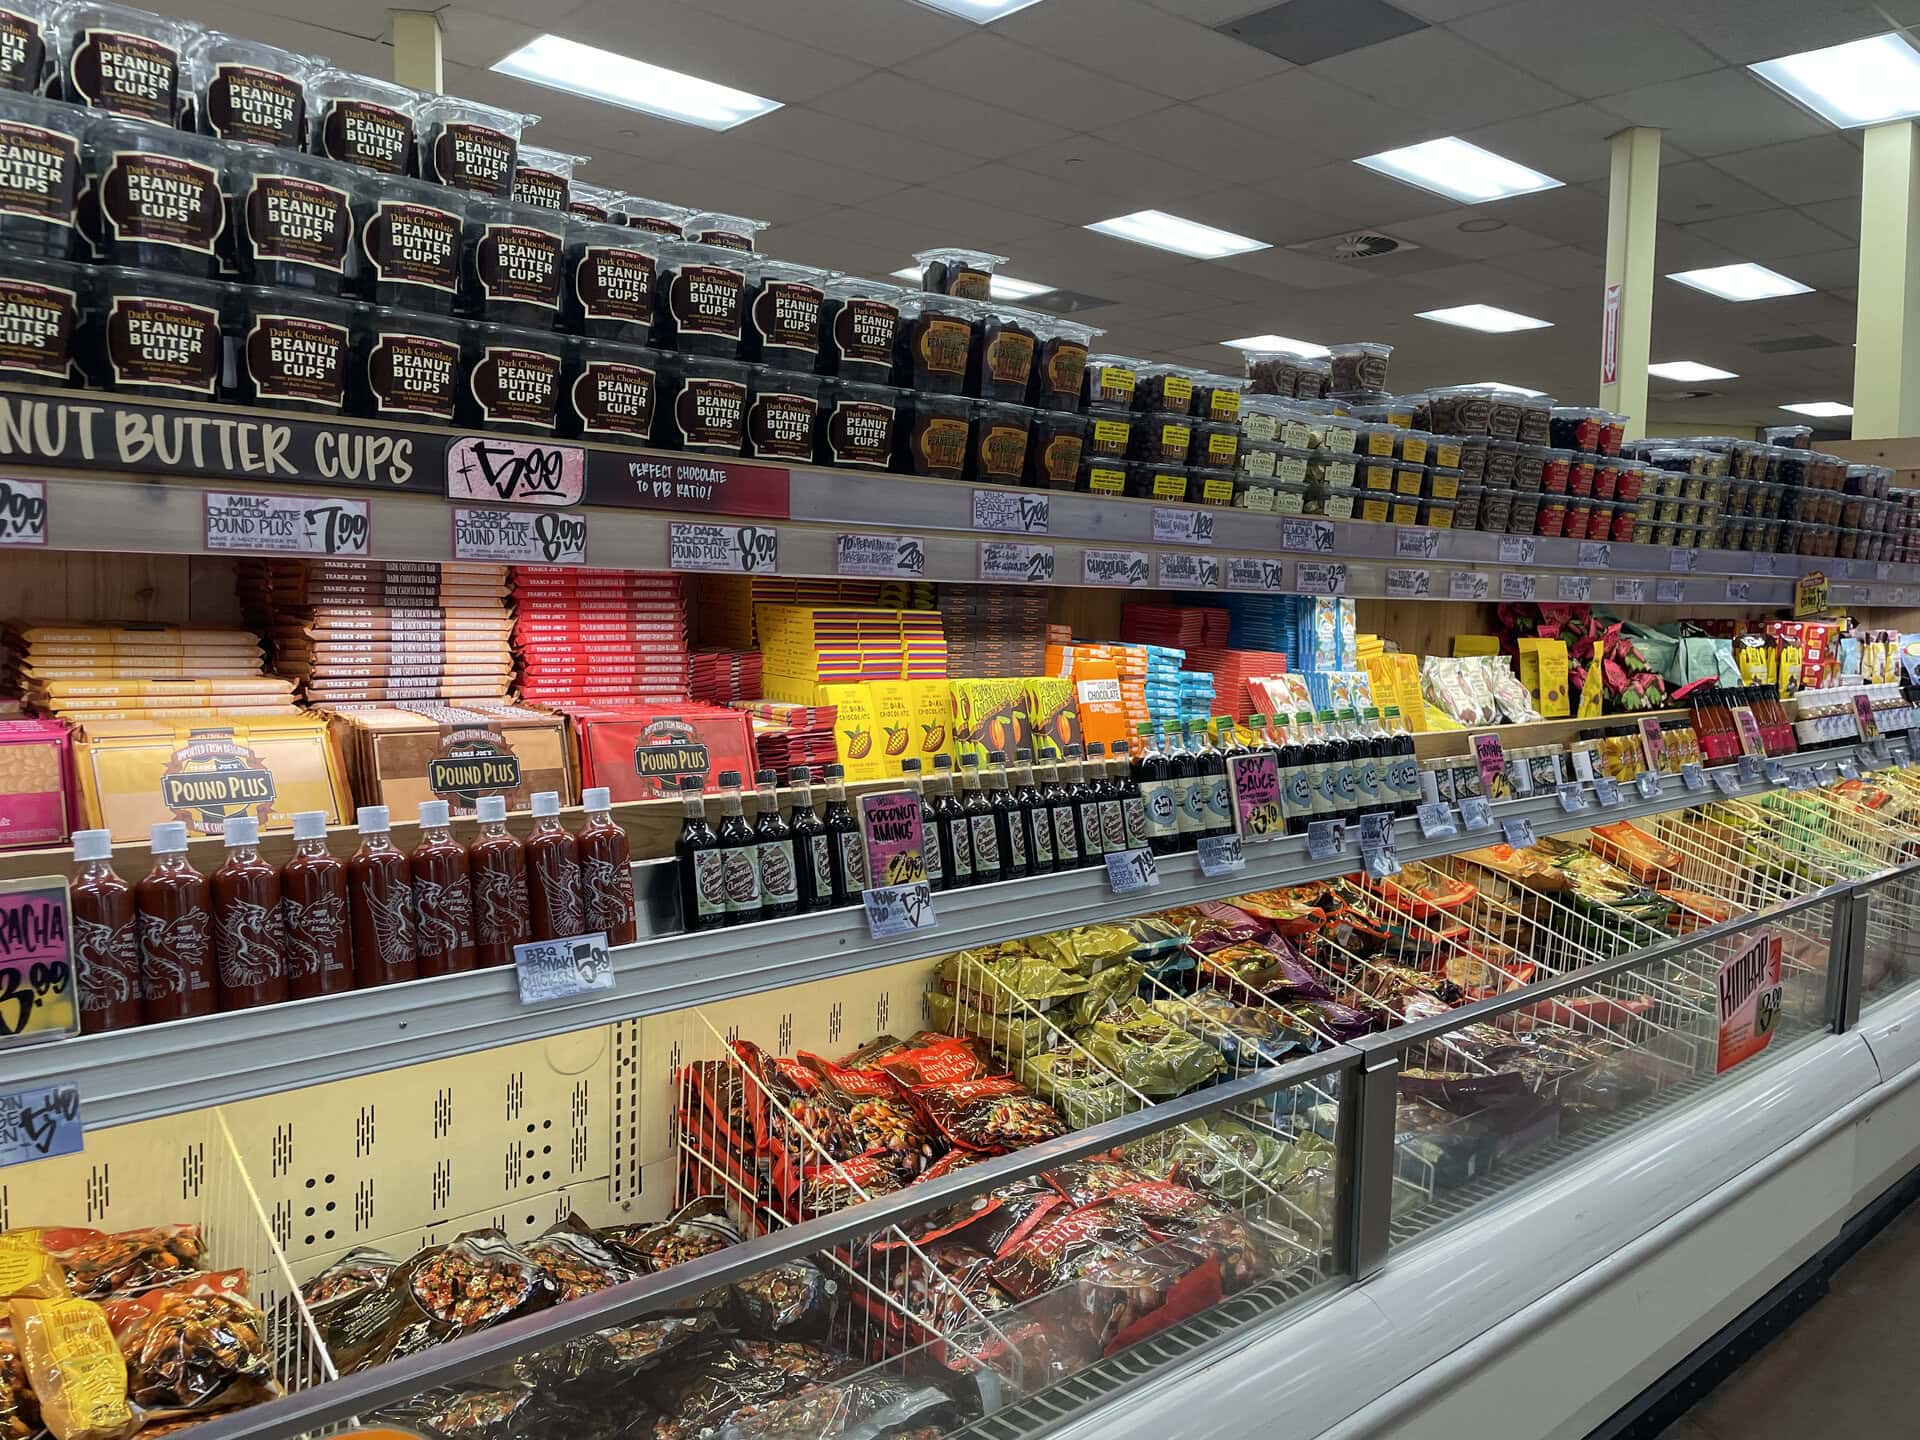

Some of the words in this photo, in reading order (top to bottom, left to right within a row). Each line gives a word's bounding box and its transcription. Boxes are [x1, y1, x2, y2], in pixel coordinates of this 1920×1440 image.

[100, 52, 171, 78] PEANUT
[102, 65, 169, 91] BUTTER
[115, 79, 158, 99] CUPS
[229, 85, 296, 109] PEANUT
[231, 97, 293, 121] BUTTER
[242, 111, 283, 130] CUPS
[346, 119, 404, 139] PEANUT
[346, 130, 403, 152] BUTTER
[357, 144, 392, 160] CUPS
[456, 140, 510, 160] PEANUT
[456, 152, 508, 173] BUTTER
[466, 164, 498, 180] CUPS
[128, 175, 203, 198] PEANUT
[514, 184, 562, 200] PEANUT
[129, 189, 200, 212] BUTTER
[268, 197, 336, 220] PEANUT
[514, 194, 560, 209] BUTTER
[142, 204, 188, 222] CUPS
[268, 210, 334, 233] BUTTER
[280, 224, 322, 242] CUPS
[392, 222, 453, 244] PEANUT
[393, 235, 450, 256] BUTTER
[403, 248, 441, 265] CUPS
[498, 244, 554, 264] PEANUT
[500, 256, 552, 275] BUTTER
[509, 268, 544, 282] CUPS
[598, 266, 648, 282] PEANUT
[598, 276, 647, 293] BUTTER
[690, 283, 737, 298] PEANUT
[608, 289, 639, 302] CUPS
[690, 292, 736, 308] BUTTER
[700, 304, 728, 317] CUPS
[776, 300, 818, 314] PEANUT
[777, 310, 817, 324] BUTTER
[854, 315, 894, 329] PEANUT
[128, 320, 204, 340] PEANUT
[784, 320, 810, 332] CUPS
[855, 325, 892, 339] BUTTER
[130, 334, 202, 353] BUTTER
[271, 337, 338, 356] PEANUT
[861, 334, 886, 346] CUPS
[142, 348, 189, 364] CUPS
[272, 350, 336, 369] BUTTER
[393, 354, 452, 372] PEANUT
[284, 364, 324, 379] CUPS
[394, 366, 450, 384] BUTTER
[498, 367, 554, 384] PEANUT
[404, 380, 440, 394] CUPS
[499, 379, 551, 394] BUTTER
[598, 381, 648, 396] PEANUT
[508, 391, 542, 404] CUPS
[599, 392, 646, 407] BUTTER
[697, 397, 742, 410] PEANUT
[608, 403, 638, 416] CUPS
[698, 407, 740, 420] BUTTER
[768, 410, 810, 423] PEANUT
[706, 418, 732, 428] CUPS
[768, 420, 808, 432] BUTTER
[847, 418, 888, 430] PEANUT
[776, 430, 802, 440] CUPS
[848, 428, 886, 440] BUTTER
[854, 437, 878, 446] CUPS
[115, 410, 299, 476] BUTTER
[315, 432, 413, 484] CUPS
[629, 463, 672, 479] PERFECT
[677, 466, 727, 483] CHOCOLATE
[637, 480, 648, 492] TO
[653, 482, 672, 498] PB
[228, 496, 270, 508] MILK
[976, 503, 1012, 511] PEANUT
[208, 507, 300, 520] CHOCOLATE
[469, 511, 510, 520] DARK
[976, 512, 1014, 520] BUTTER
[208, 518, 254, 534] POUND
[260, 520, 292, 536] PLUS
[456, 520, 530, 530] CHOCOLATE
[694, 527, 724, 536] DARK
[456, 529, 494, 546] POUND
[500, 530, 526, 546] PLUS
[672, 536, 732, 546] CHOCOLATE
[672, 545, 700, 559] POUND
[704, 548, 727, 560] PLUS
[1088, 690, 1119, 700] CHOCOLATE
[640, 752, 677, 771] POUND
[678, 750, 705, 768] PLUS
[1239, 758, 1264, 776] SOY
[436, 766, 480, 786] POUND
[483, 762, 515, 784] PLUS
[170, 780, 226, 802] POUND
[228, 776, 268, 798] PLUS
[1236, 774, 1275, 794] SAUCE
[868, 804, 916, 822] COCONUT
[873, 820, 912, 842] AMINOS
[526, 947, 557, 960] BBQ
[947, 1052, 967, 1064] Pao
[925, 1059, 977, 1082] CHICKEN
